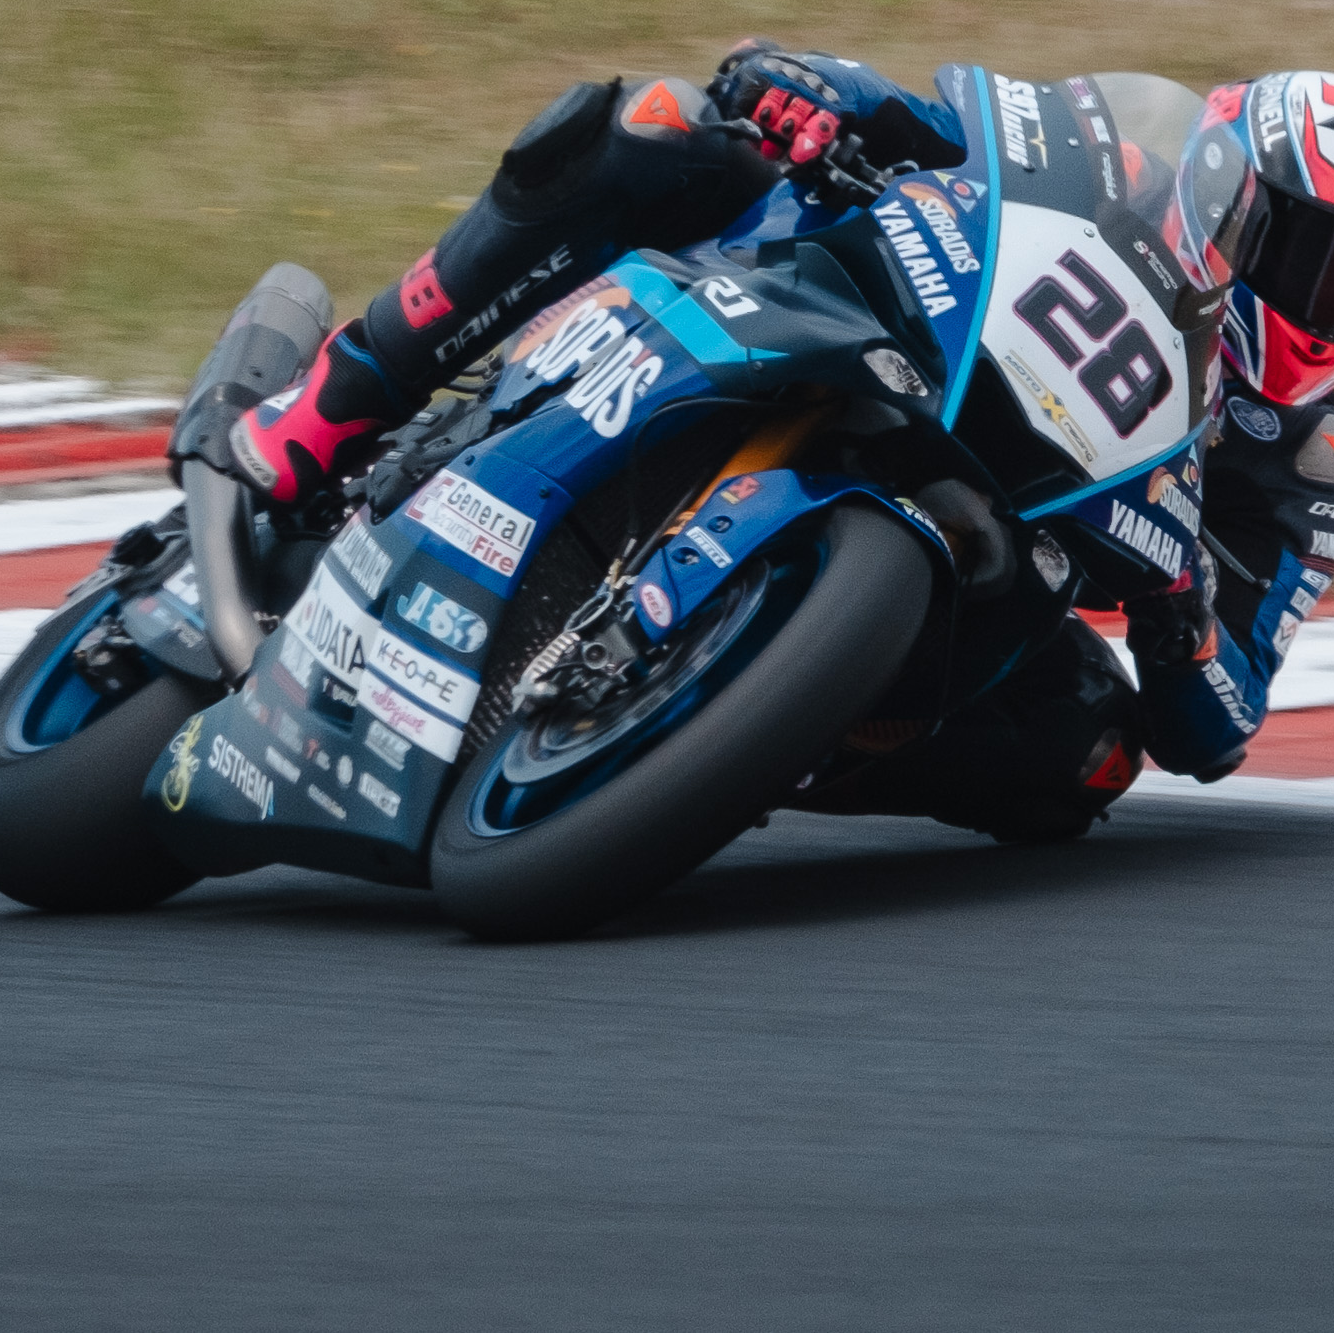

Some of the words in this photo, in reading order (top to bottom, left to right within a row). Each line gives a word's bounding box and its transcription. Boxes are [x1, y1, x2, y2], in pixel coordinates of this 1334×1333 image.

[874, 199, 958, 318] YAMAHA
[434, 244, 572, 363] DAINESE
[1004, 354, 1043, 394] MOTO
[1012, 247, 1174, 440] 28
[447, 481, 532, 548] General
[1108, 498, 1183, 580] YAMAHA
[470, 534, 516, 573] Fire
[378, 638, 459, 704] KEOPE
